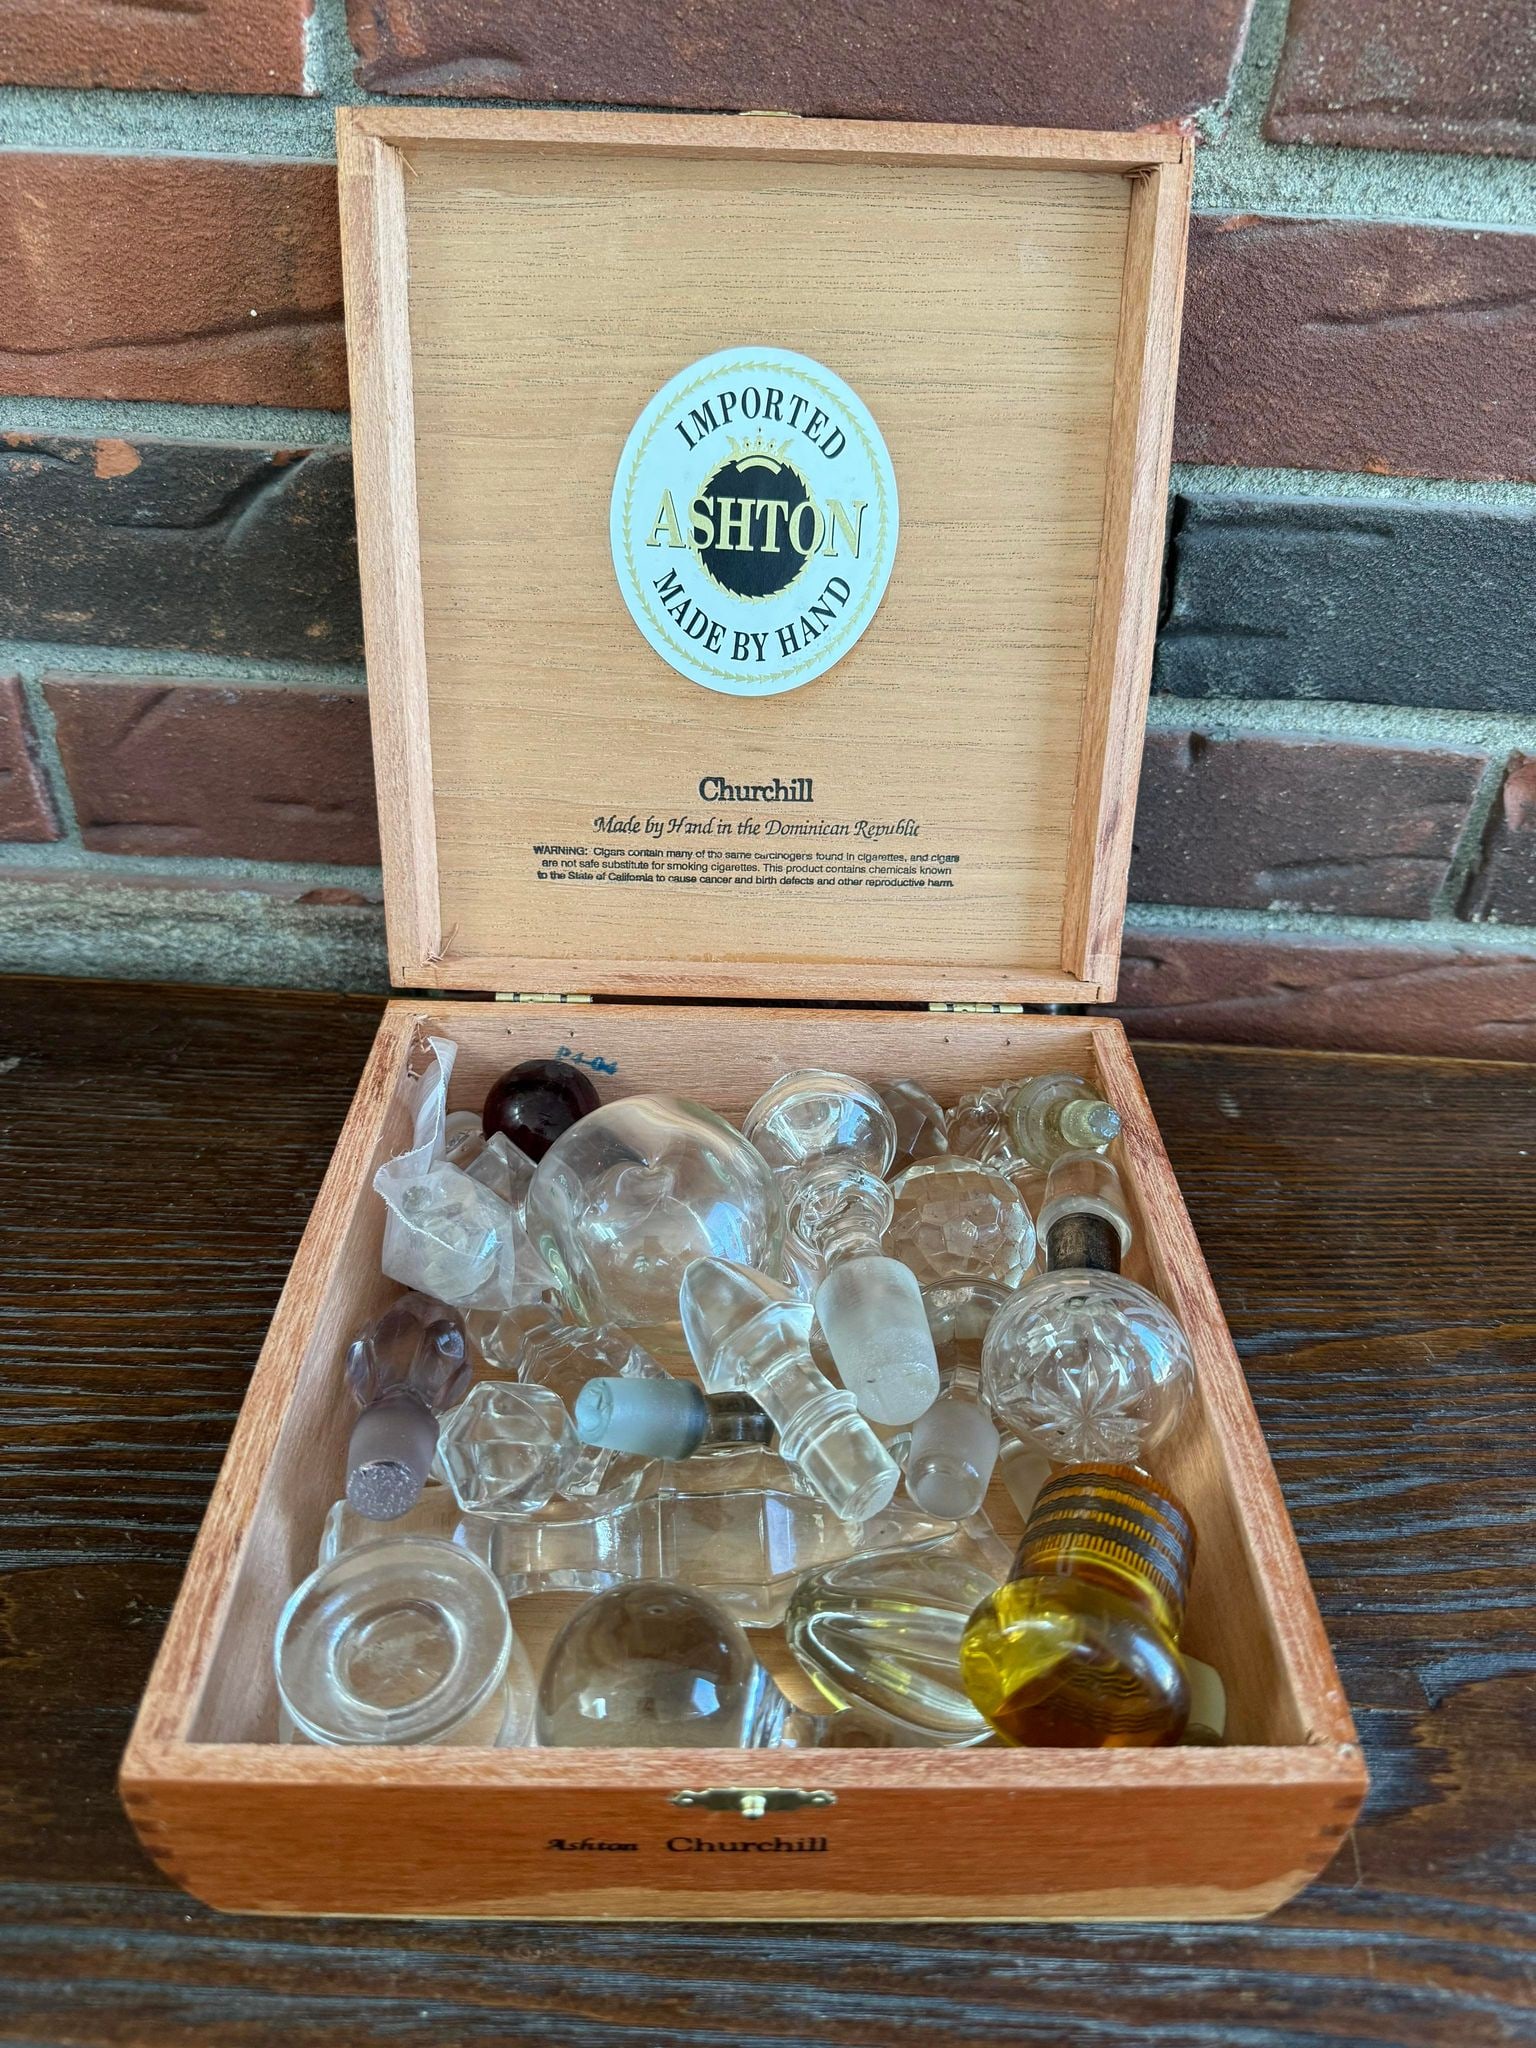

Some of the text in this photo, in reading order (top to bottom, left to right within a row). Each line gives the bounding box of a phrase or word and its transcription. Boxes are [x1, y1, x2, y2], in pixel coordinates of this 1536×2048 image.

[674, 386, 847, 460] IMPORTED
[646, 487, 869, 560] ASHTON
[652, 567, 852, 663] MADE BY HAND
[698, 776, 814, 803] Churchill
[593, 815, 921, 841] Made by Hand in the Dominican Republic
[533, 845, 960, 864] WARNING: Cigars contain many of the same carcinogens found in cigarettes, and cigars
[542, 859, 952, 875] are not safe substitute for smoking cigarettes. This product contains chemicals known
[537, 871, 954, 888] to the State of California to cause cancer and birth defects and other reproductive harm.
[546, 1836, 829, 1853] Ashton Churchill
